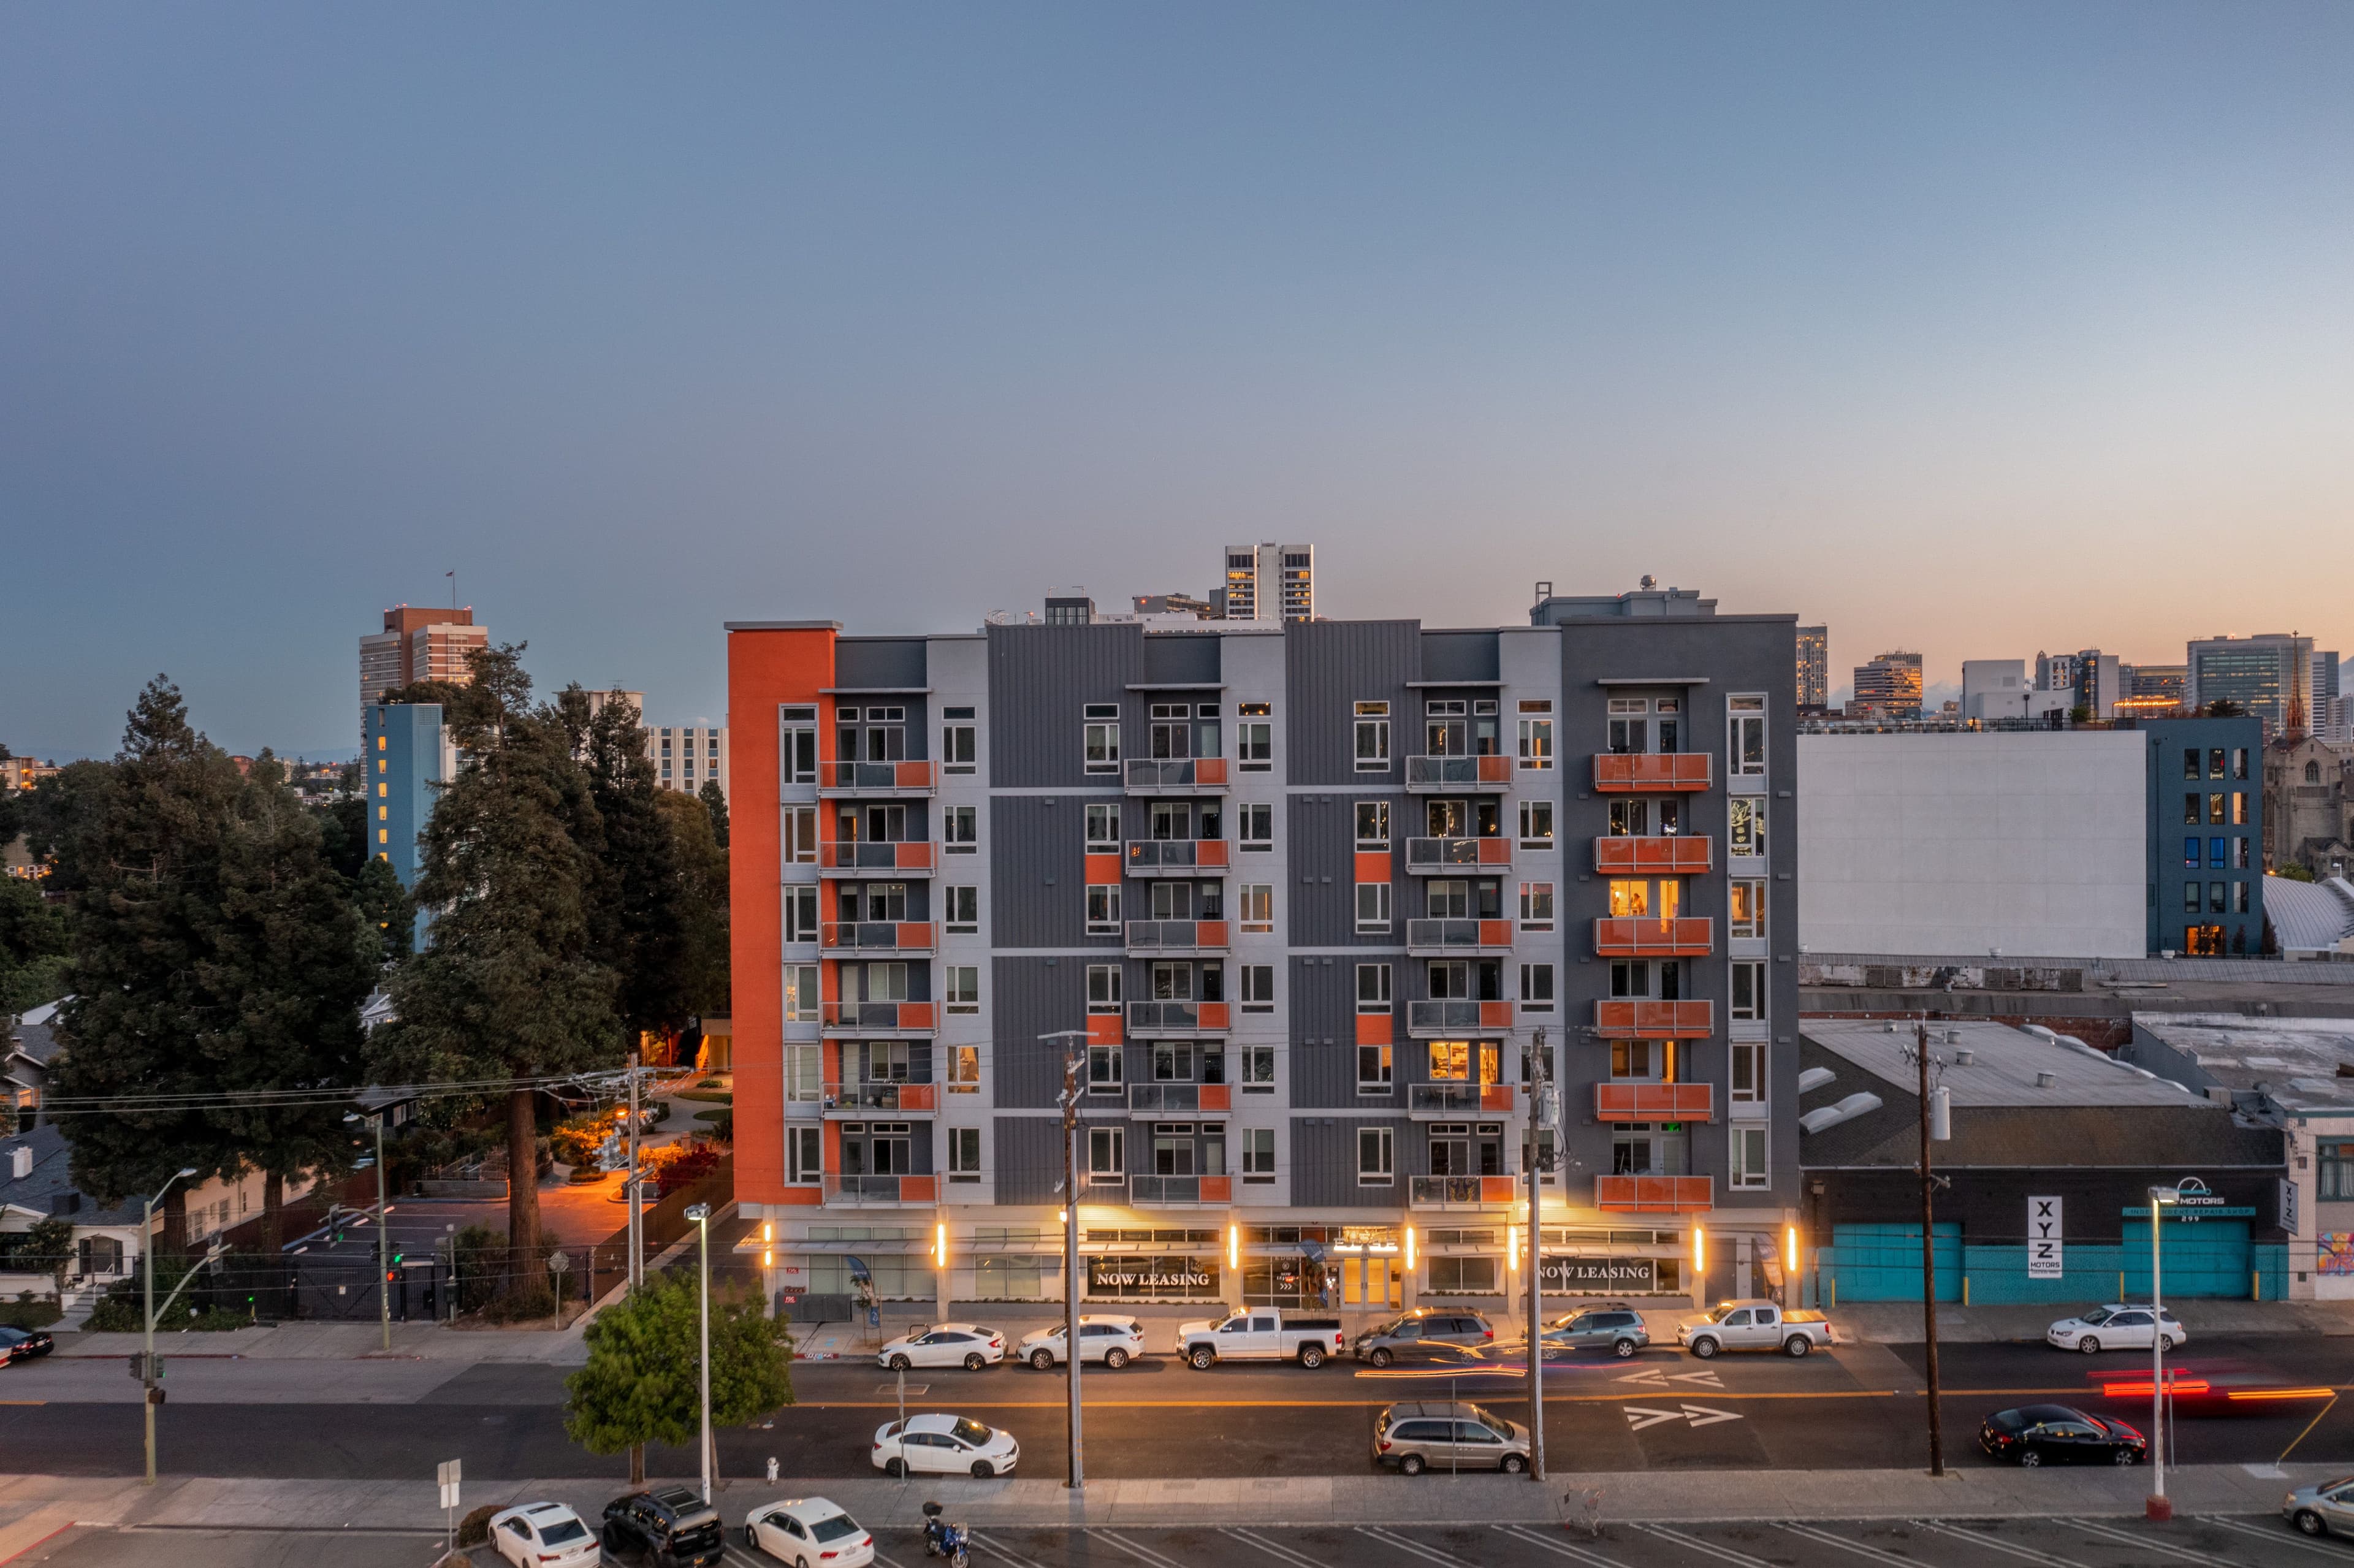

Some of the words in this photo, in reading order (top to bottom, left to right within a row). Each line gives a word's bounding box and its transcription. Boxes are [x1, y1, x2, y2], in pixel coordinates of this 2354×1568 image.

[2037, 1201, 2053, 1258] XYZ
[1097, 1273, 1137, 1285] NOW
[1138, 1273, 1209, 1285] LEASING
[1577, 1266, 1650, 1279] LEASING
